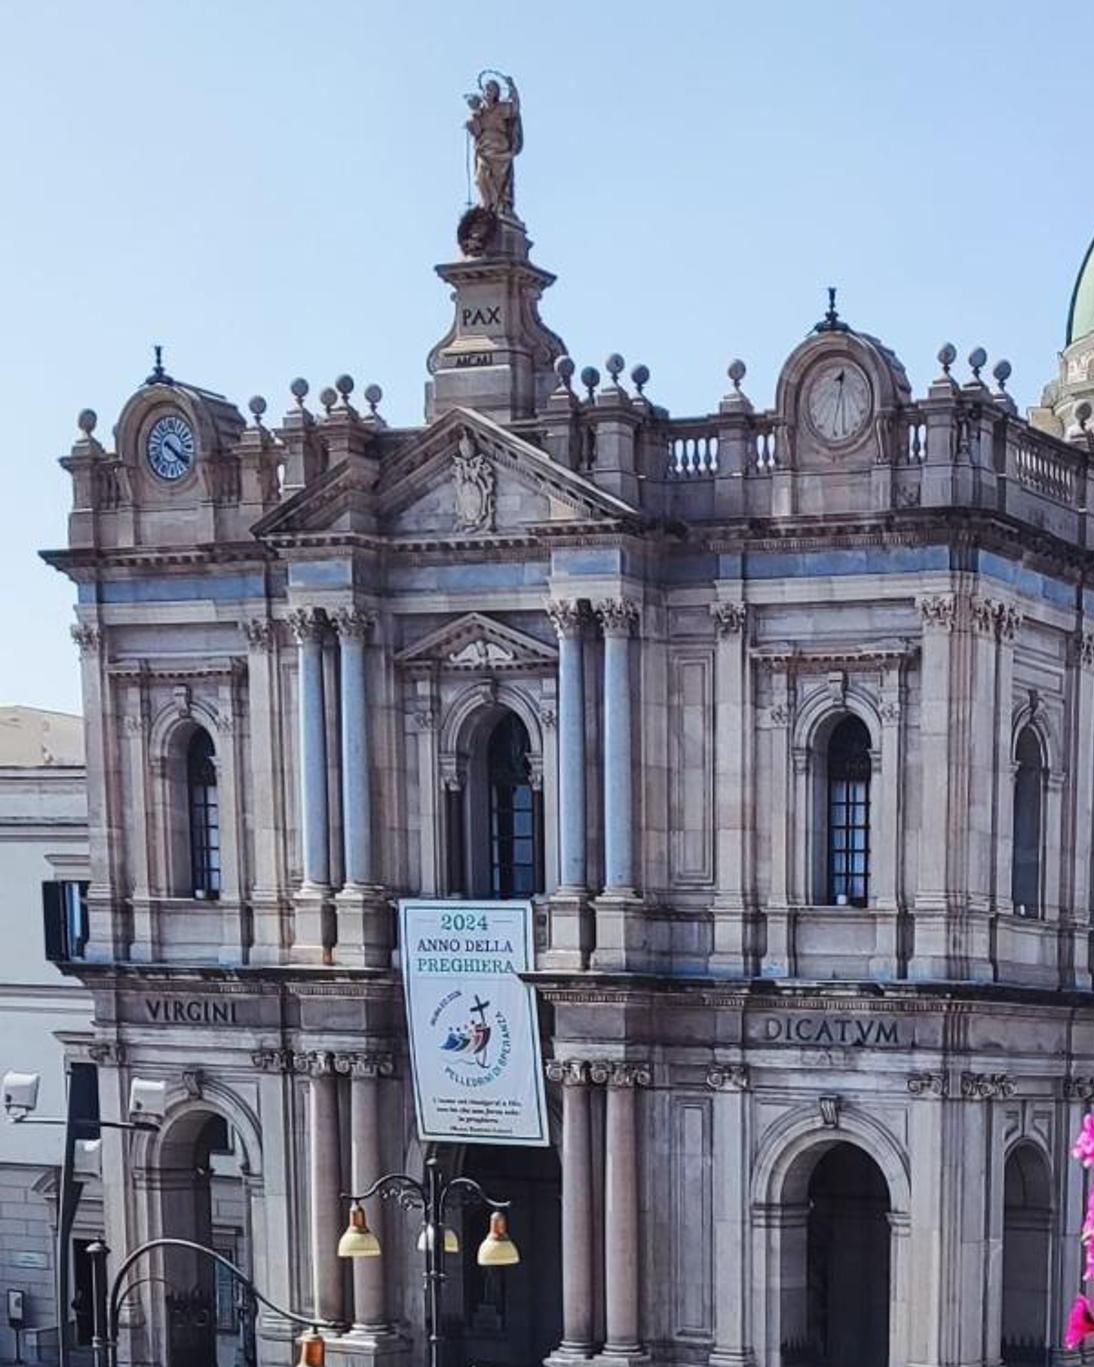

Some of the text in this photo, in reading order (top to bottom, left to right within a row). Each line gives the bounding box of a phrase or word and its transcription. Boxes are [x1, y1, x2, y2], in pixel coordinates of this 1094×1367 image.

[462, 306, 502, 326] PAX
[441, 914, 488, 931] 2024
[417, 938, 513, 953] ANNO DELLA
[417, 958, 516, 973] PREGHIERA
[145, 999, 238, 1024] VIRGINI
[765, 1017, 899, 1043] DICATVM
